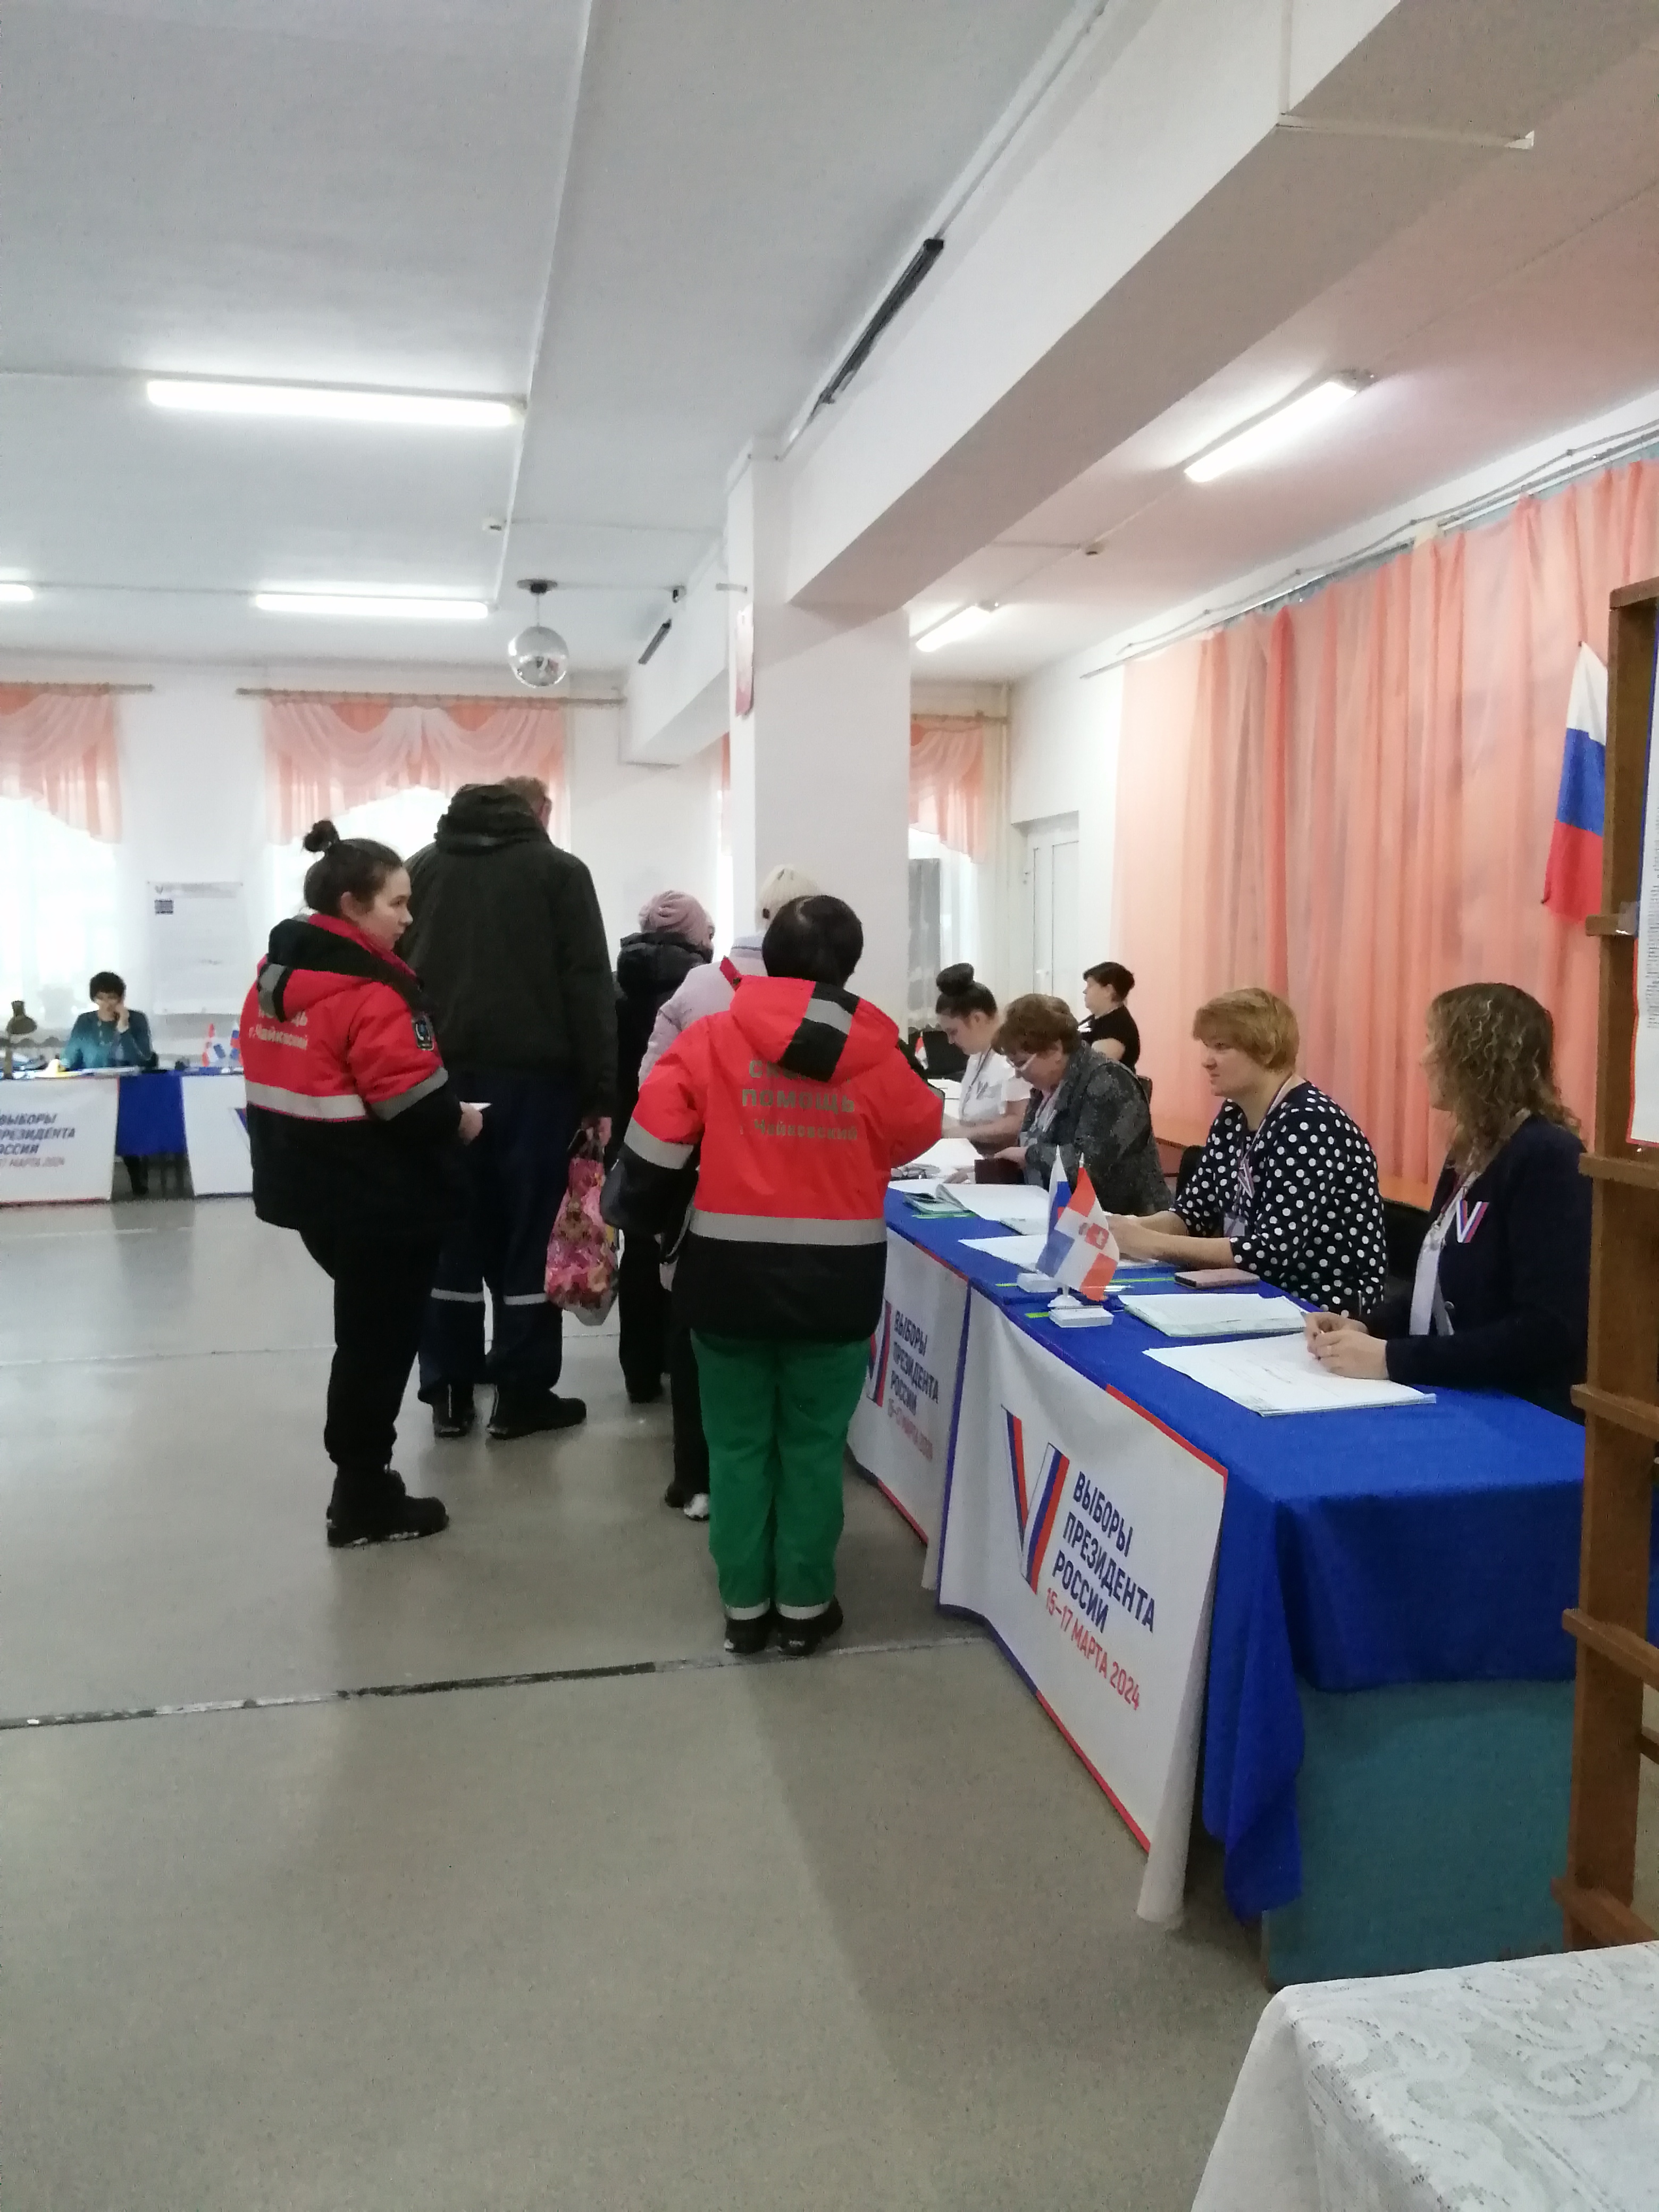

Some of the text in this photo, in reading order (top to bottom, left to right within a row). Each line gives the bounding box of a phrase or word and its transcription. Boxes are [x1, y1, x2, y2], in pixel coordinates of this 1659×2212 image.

[0, 1128, 76, 1140] РЕЗИДЕНТА
[0, 1144, 39, 1155] ОССИИ
[894, 1309, 928, 1357] ВЫБОРЫ
[891, 1370, 918, 1416] РОССИИ
[893, 1341, 939, 1404] ПРЕЗИДЕНТА
[1073, 1471, 1133, 1558] ВЫБОРЫ
[1052, 1549, 1109, 1633] РОССИИ
[1062, 1511, 1155, 1633] ПРЕЗИДЕНТА
[1071, 1617, 1108, 1679] МАРТА
[1109, 1661, 1141, 1711] 2024
